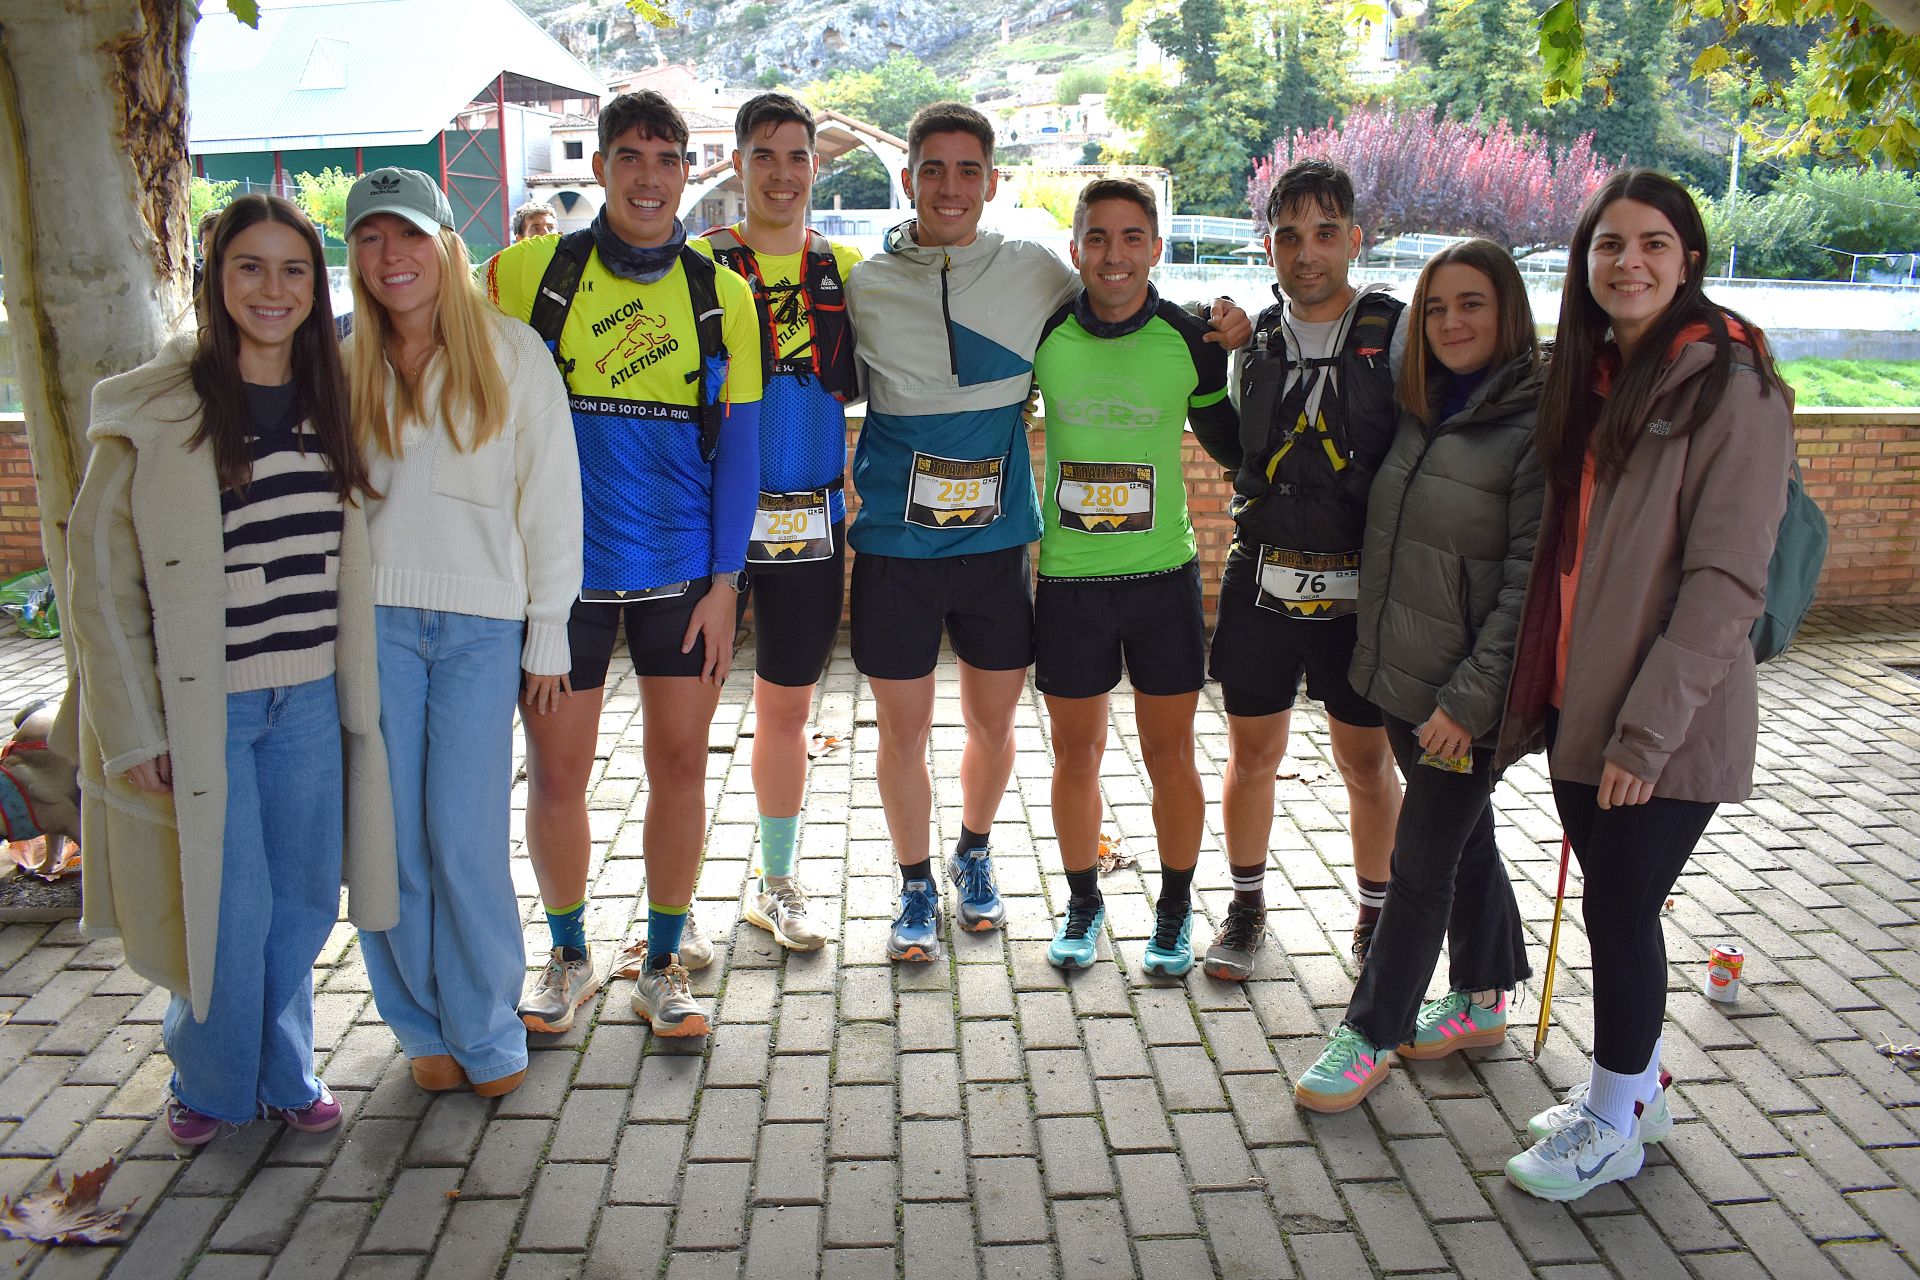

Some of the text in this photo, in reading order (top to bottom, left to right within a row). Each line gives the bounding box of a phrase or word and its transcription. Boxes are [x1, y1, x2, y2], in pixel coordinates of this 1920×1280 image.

[591, 298, 644, 337] RINCON
[611, 338, 679, 389] ATLETISMO
[568, 398, 597, 411] NCÓN
[600, 402, 616, 413] DE
[670, 409, 690, 420] RIO
[932, 460, 966, 477] TRAIL
[1075, 466, 1108, 479] TRAIL
[1111, 466, 1136, 479] 13K
[936, 481, 981, 502] 293
[1081, 484, 1129, 507] 280
[767, 511, 808, 535] 250
[1294, 572, 1327, 593] 76
